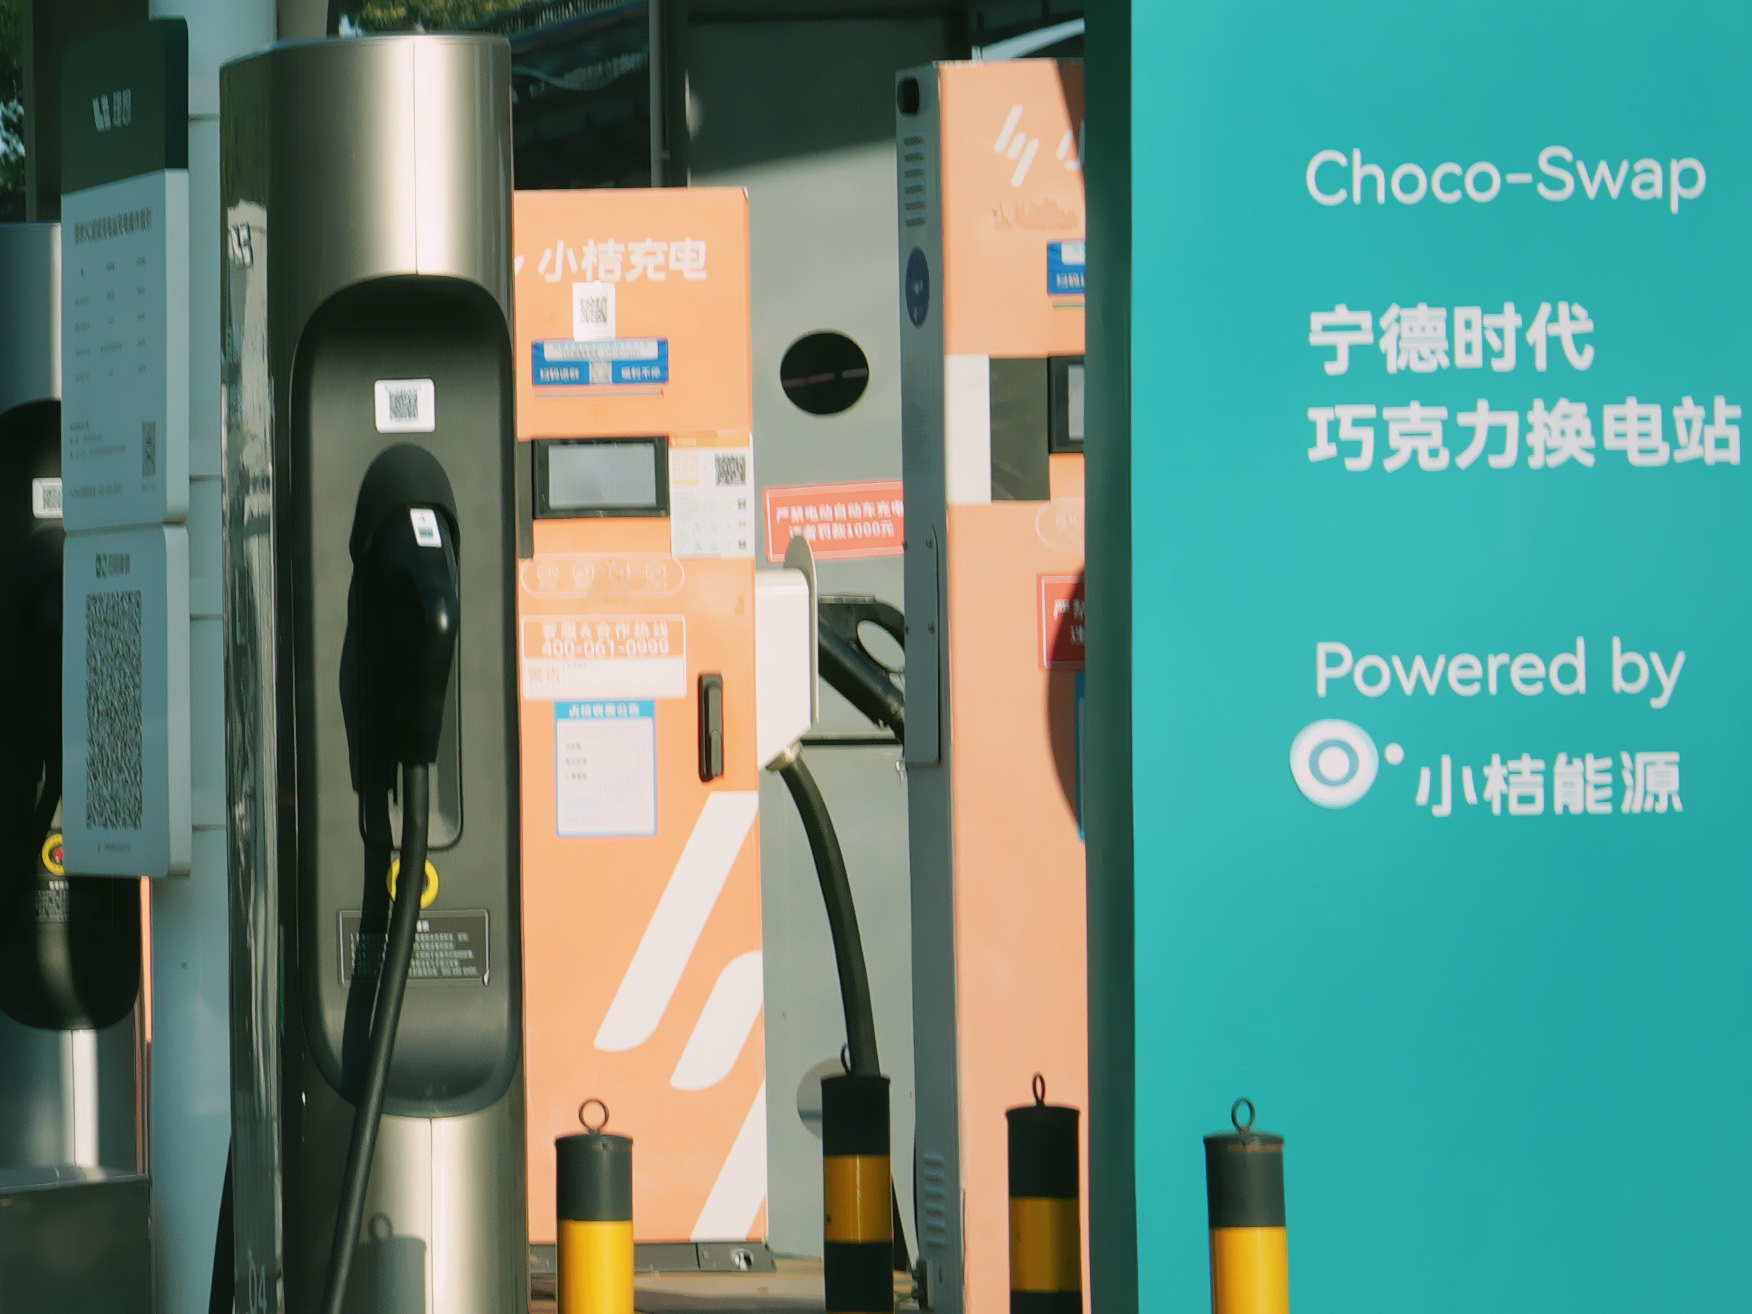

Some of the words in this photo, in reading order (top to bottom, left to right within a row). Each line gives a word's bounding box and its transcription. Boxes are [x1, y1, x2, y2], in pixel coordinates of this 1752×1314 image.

[1305, 145, 1707, 215] Choco-Swap
[537, 237, 708, 283] 小桔充电
[1308, 301, 1595, 376] 宁德时代
[1307, 395, 1742, 473] 巧克力换电站
[1316, 635, 1587, 698] Powered
[1612, 635, 1686, 710] by
[1415, 751, 1684, 818] 小桔能源
